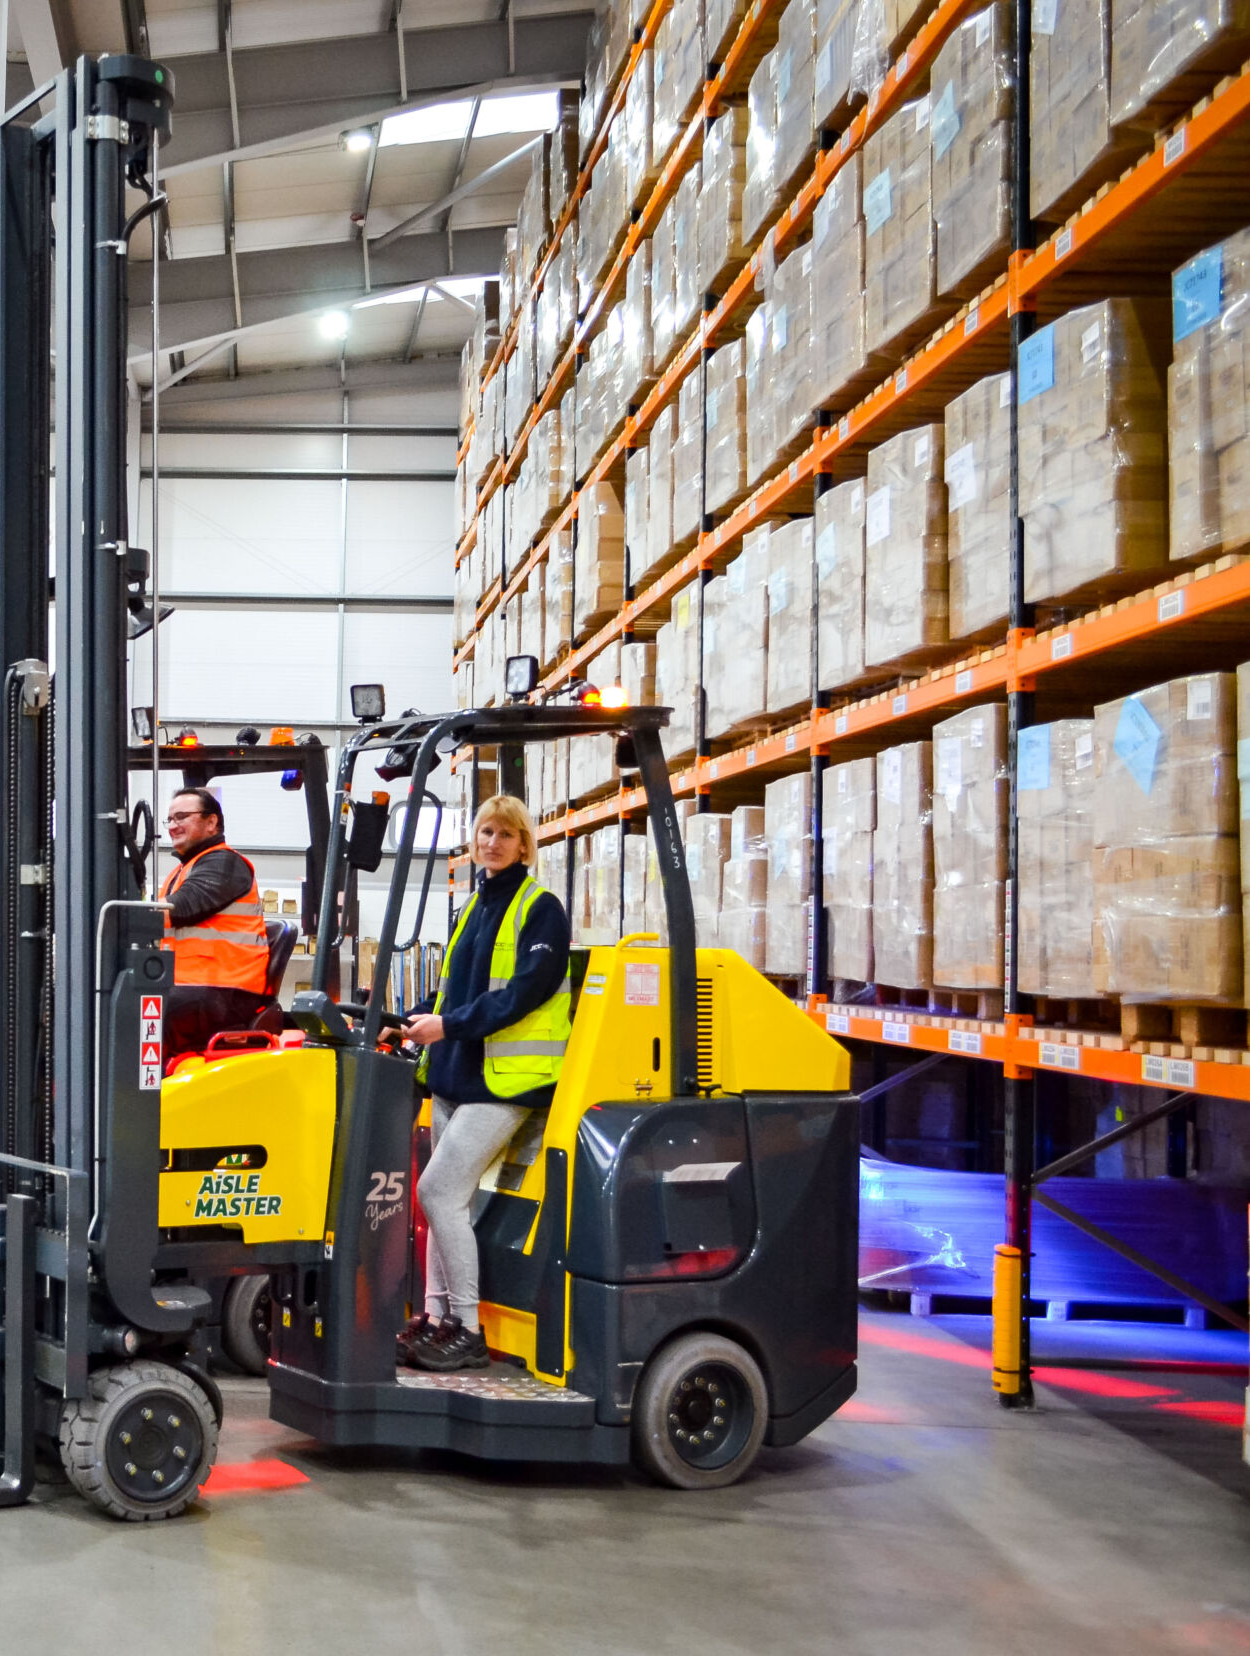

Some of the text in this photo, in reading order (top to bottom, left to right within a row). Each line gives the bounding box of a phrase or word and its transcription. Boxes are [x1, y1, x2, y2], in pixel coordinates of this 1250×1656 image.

[664, 807, 681, 869] 10163
[198, 1174, 261, 1195] AiSLE
[365, 1171, 406, 1201] 25
[194, 1196, 282, 1217] MASTER
[365, 1202, 404, 1231] Years
